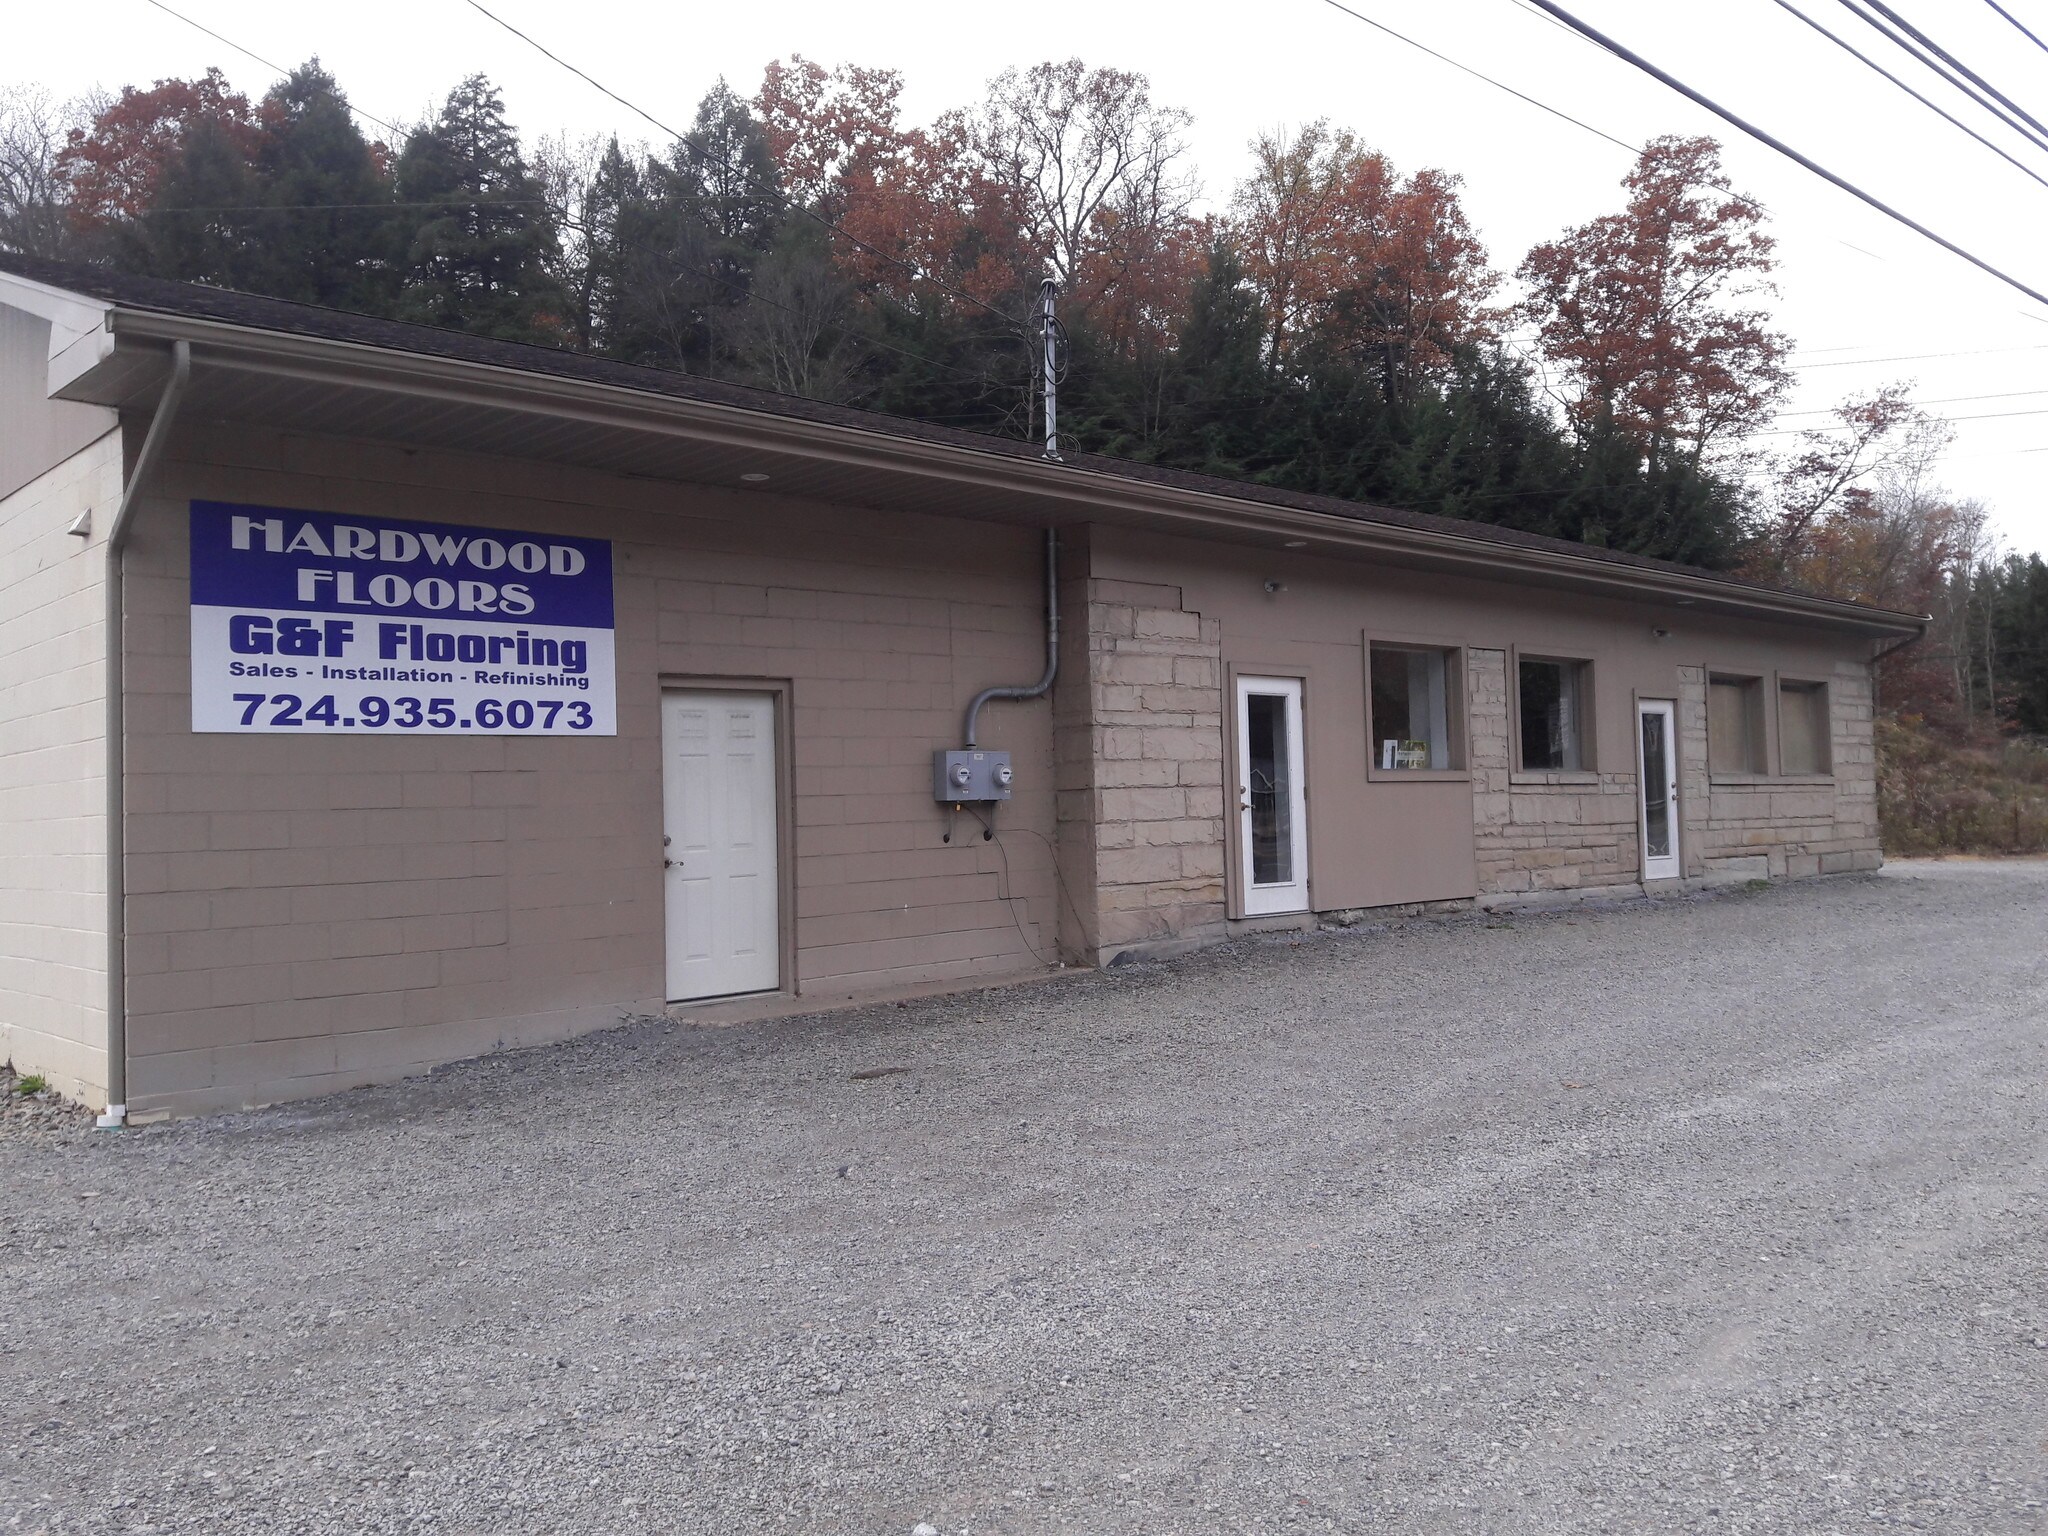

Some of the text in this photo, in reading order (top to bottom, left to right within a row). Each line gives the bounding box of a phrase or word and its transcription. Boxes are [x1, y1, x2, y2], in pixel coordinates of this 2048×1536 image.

[231, 515, 586, 576] HARDWOOD
[297, 568, 535, 615] FLOORS
[229, 615, 587, 674] G&F Flooring
[229, 661, 298, 679] Sales
[321, 665, 453, 683] Installation
[474, 670, 590, 690] Refinishing
[232, 693, 594, 730] 724.935.6073
